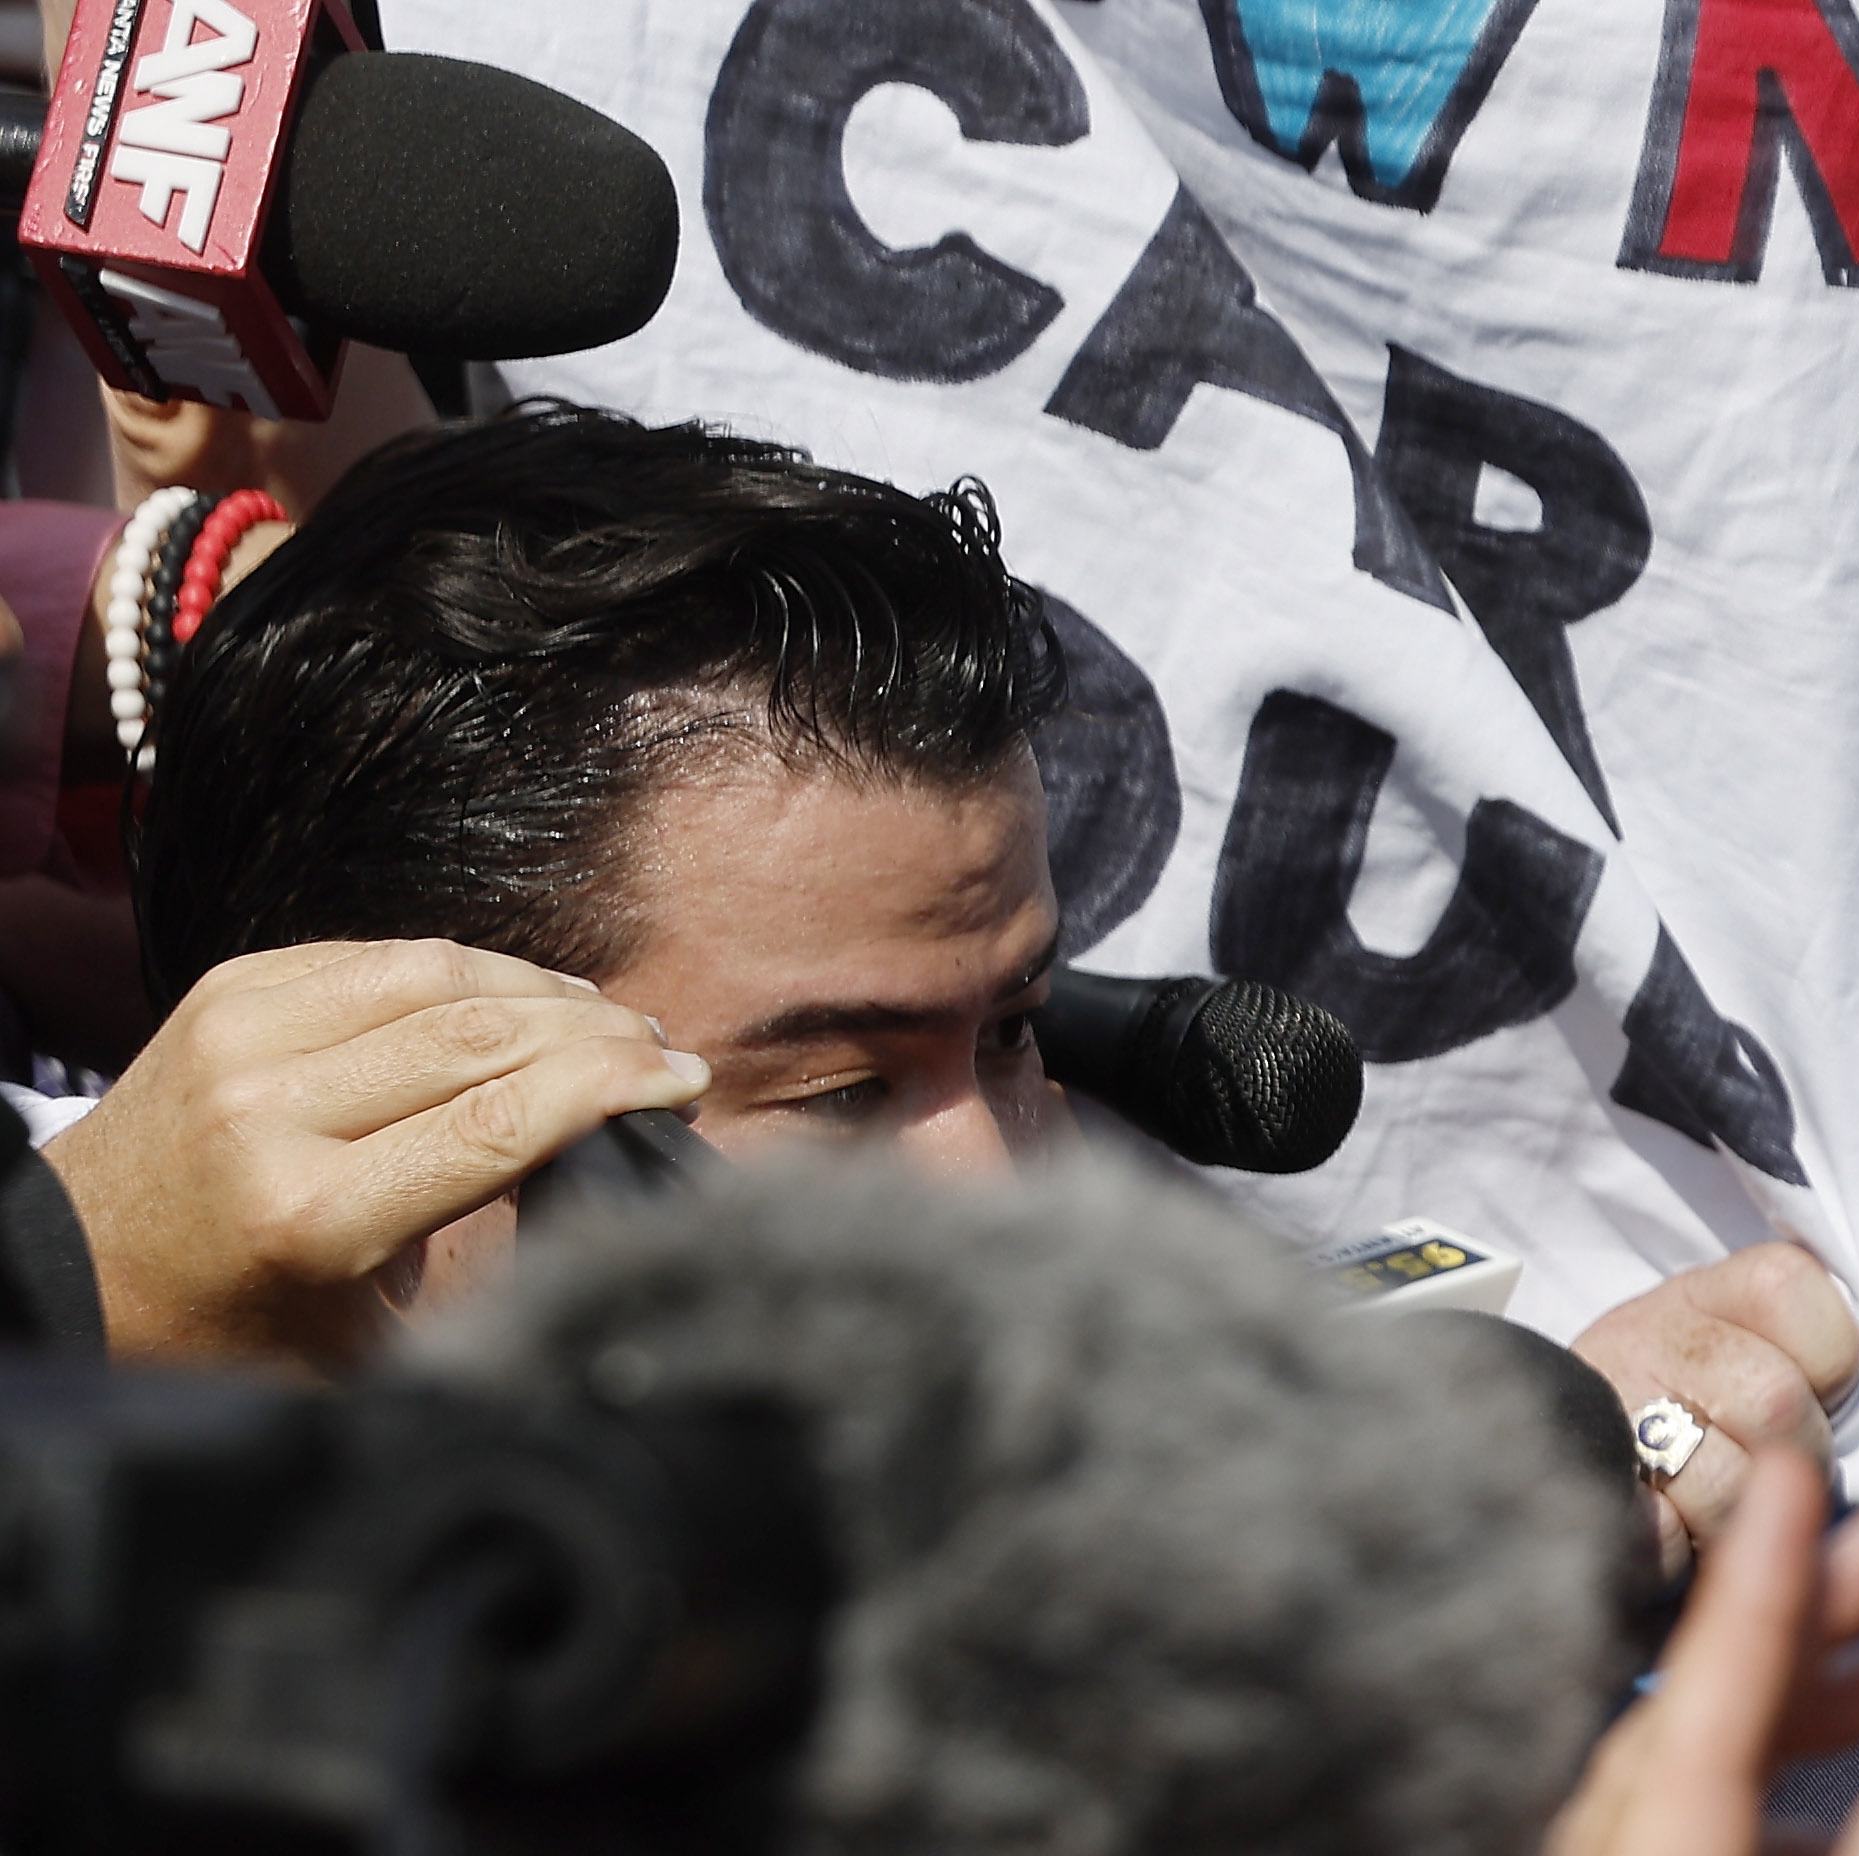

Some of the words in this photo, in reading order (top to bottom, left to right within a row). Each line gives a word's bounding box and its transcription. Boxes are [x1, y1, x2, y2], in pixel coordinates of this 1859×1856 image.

[85, 59, 123, 138] NEWS
[110, 0, 261, 252] ANF
[702, 0, 1654, 842] CAR
